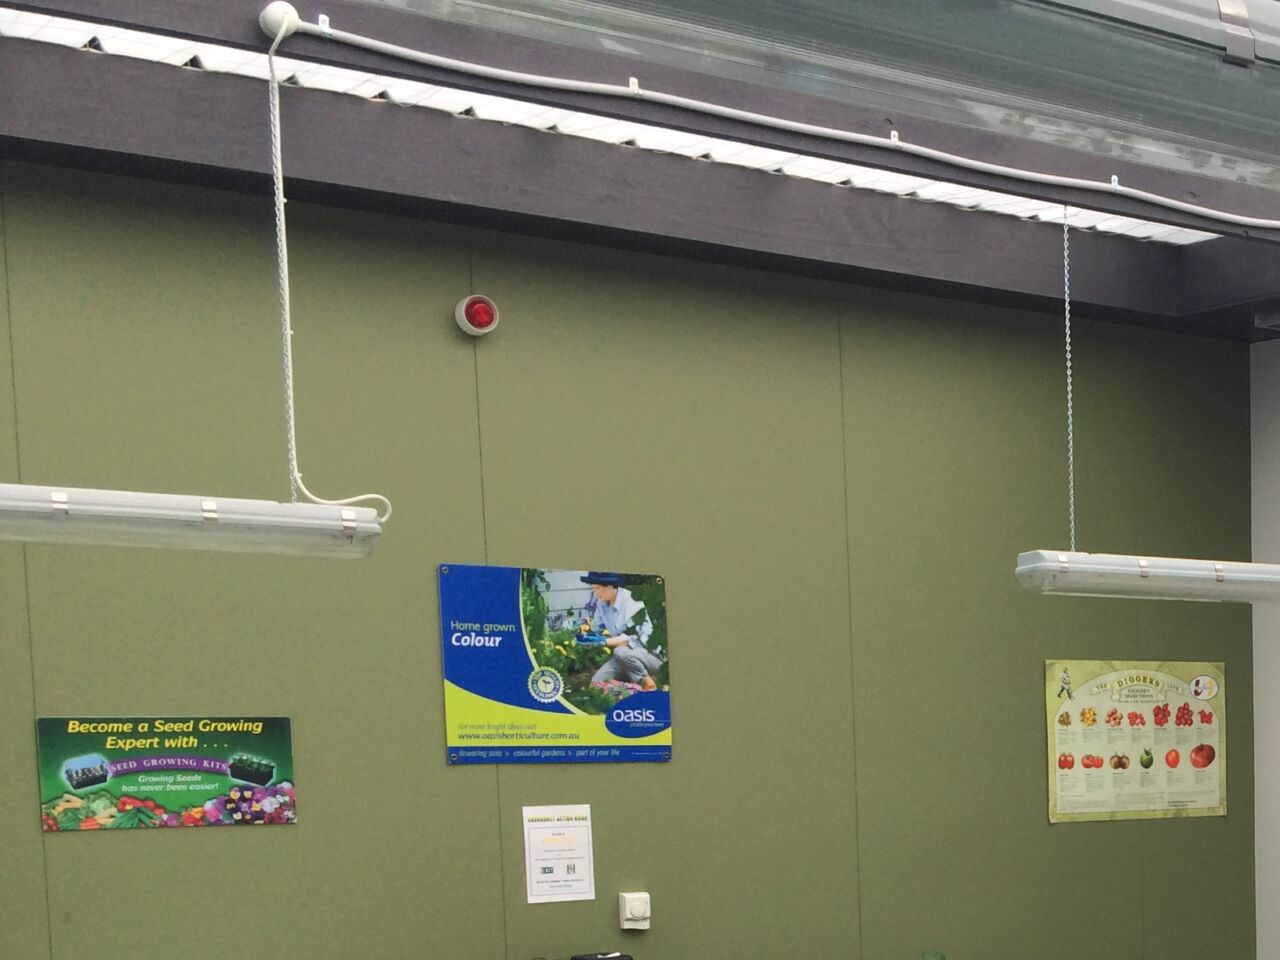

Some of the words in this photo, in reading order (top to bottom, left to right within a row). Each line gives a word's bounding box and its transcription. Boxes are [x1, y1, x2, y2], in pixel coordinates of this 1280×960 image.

[450, 620, 480, 631] Home
[483, 623, 516, 634] grown
[451, 632, 502, 647] Colour
[1117, 675, 1160, 688] DIGGERS
[612, 708, 655, 722] oasis
[67, 720, 133, 733] Become
[138, 722, 149, 732] a
[153, 719, 194, 732] Seed
[199, 719, 263, 734] Growing
[105, 736, 160, 751] Expert
[164, 736, 198, 748] with
[110, 760, 137, 772] SEED
[143, 758, 197, 767] GROWING
[203, 759, 227, 770] KITS
[138, 775, 174, 784] Growing
[175, 774, 202, 782] Seeds
